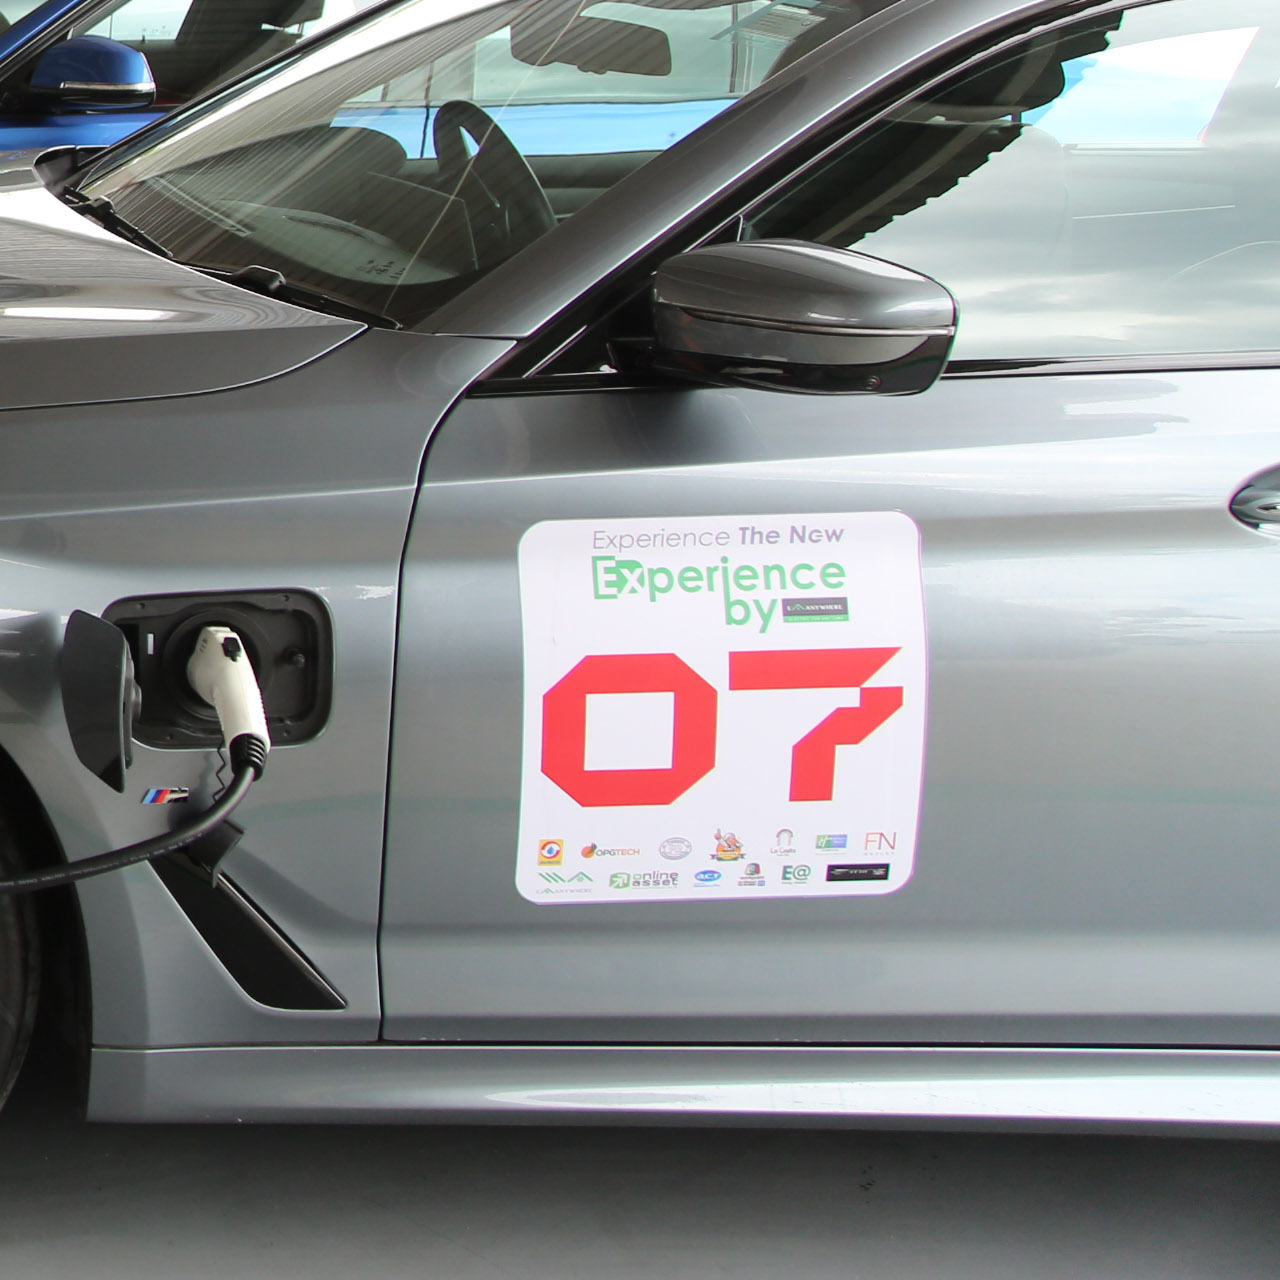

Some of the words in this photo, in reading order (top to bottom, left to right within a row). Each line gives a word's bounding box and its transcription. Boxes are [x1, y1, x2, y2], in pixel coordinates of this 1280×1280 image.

[593, 528, 731, 553] Experience
[739, 526, 781, 545] The
[790, 525, 845, 544] New
[592, 556, 847, 602] Experience
[724, 594, 778, 634] by
[541, 647, 904, 807] 07
[596, 848, 640, 857] OPGTECH
[864, 832, 896, 850] FN
[632, 871, 679, 880] online
[632, 879, 679, 887] asset
